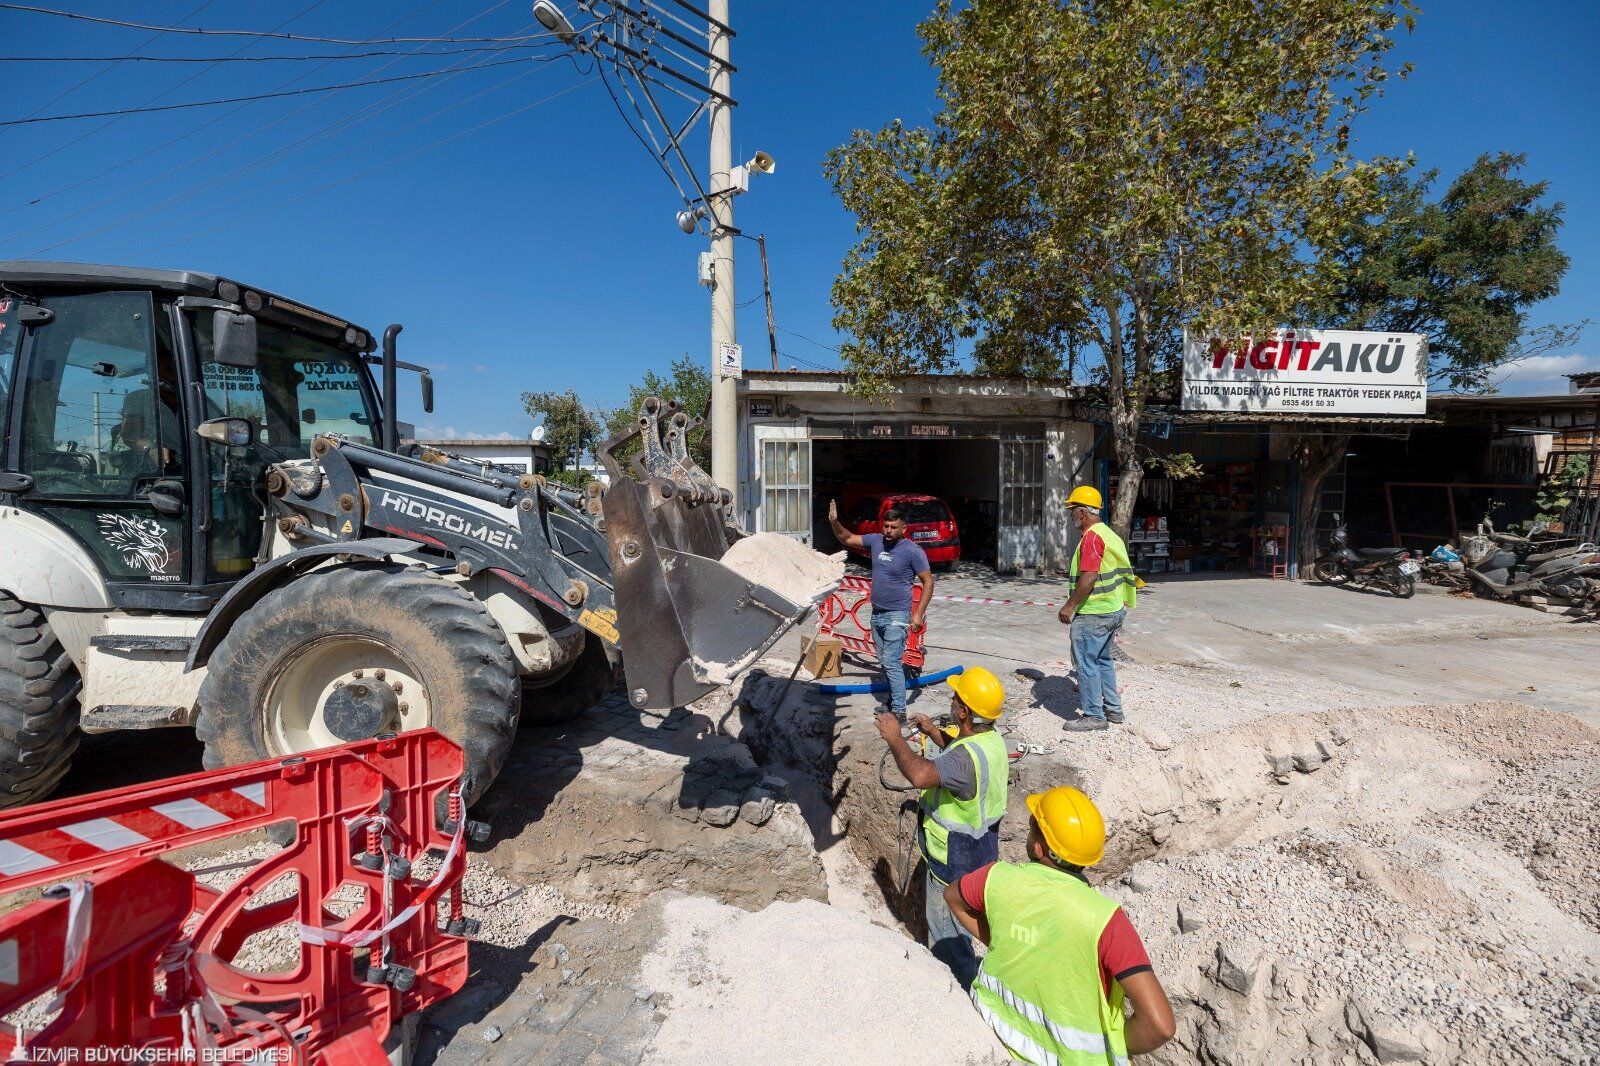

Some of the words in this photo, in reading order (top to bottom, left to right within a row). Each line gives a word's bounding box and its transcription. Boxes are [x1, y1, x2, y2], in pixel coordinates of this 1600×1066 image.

[1188, 385, 1220, 395] YILDIZ
[1222, 384, 1259, 396] MADENİ
[1262, 386, 1280, 396] YAĞ
[1283, 386, 1314, 397] FİLTRE
[1362, 390, 1391, 399] YEDEK
[1393, 390, 1422, 401] PARÇA
[1281, 399, 1299, 407] 0535
[872, 425, 892, 435] OTO
